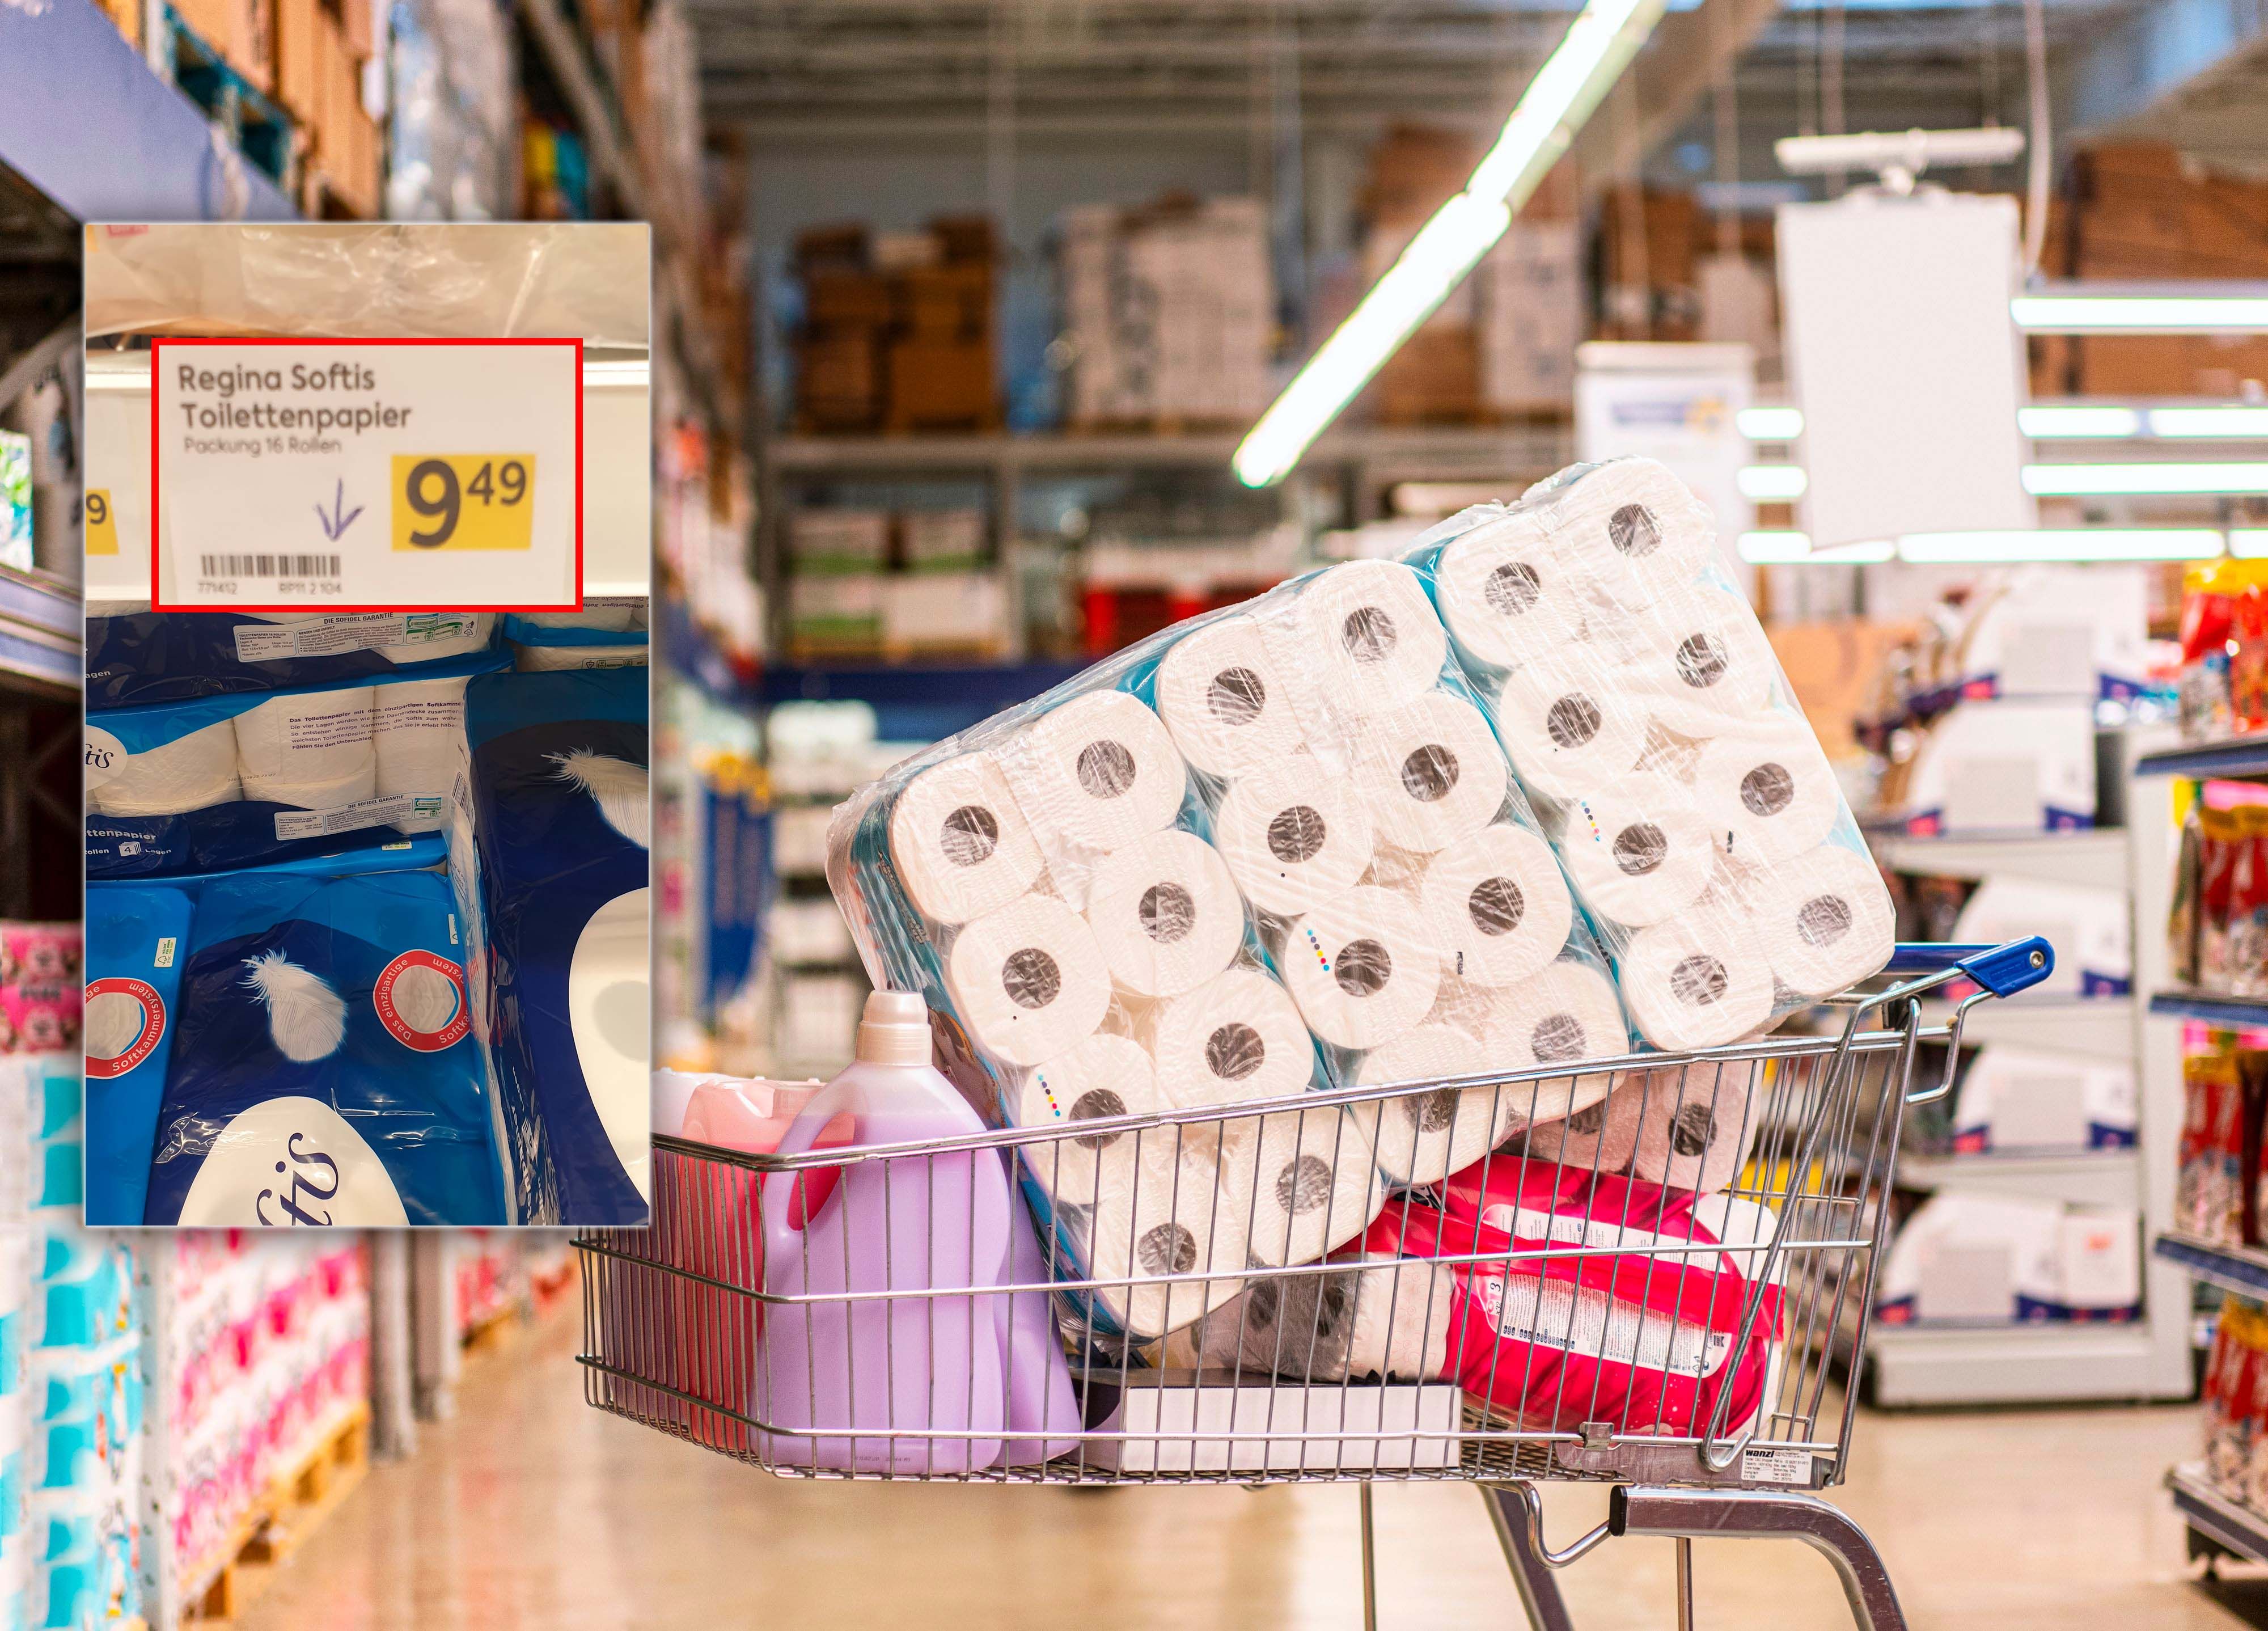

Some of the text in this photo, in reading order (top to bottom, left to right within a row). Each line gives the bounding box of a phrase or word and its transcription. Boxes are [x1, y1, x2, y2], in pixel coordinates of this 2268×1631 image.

[178, 362, 375, 398] Regina Softis
[180, 400, 412, 435] Toilettenpapier
[184, 436, 342, 458] Packung 16 Rollen
[362, 612, 393, 621] GARANTIE
[85, 670, 111, 679] agen
[304, 712, 351, 721] Toilettenpapier
[384, 703, 424, 712] einzigartigen
[387, 709, 426, 719] Daunendecke
[323, 730, 366, 741] Toilettenpapier
[337, 736, 374, 745] Unterschied.
[85, 829, 156, 840] ttenpapier
[379, 959, 412, 1041] Das einzigartige
[112, 983, 160, 1071] Softkammersystem
[511, 1105, 532, 1226] ttenpapier
[1490, 1282, 1501, 1292] 3
